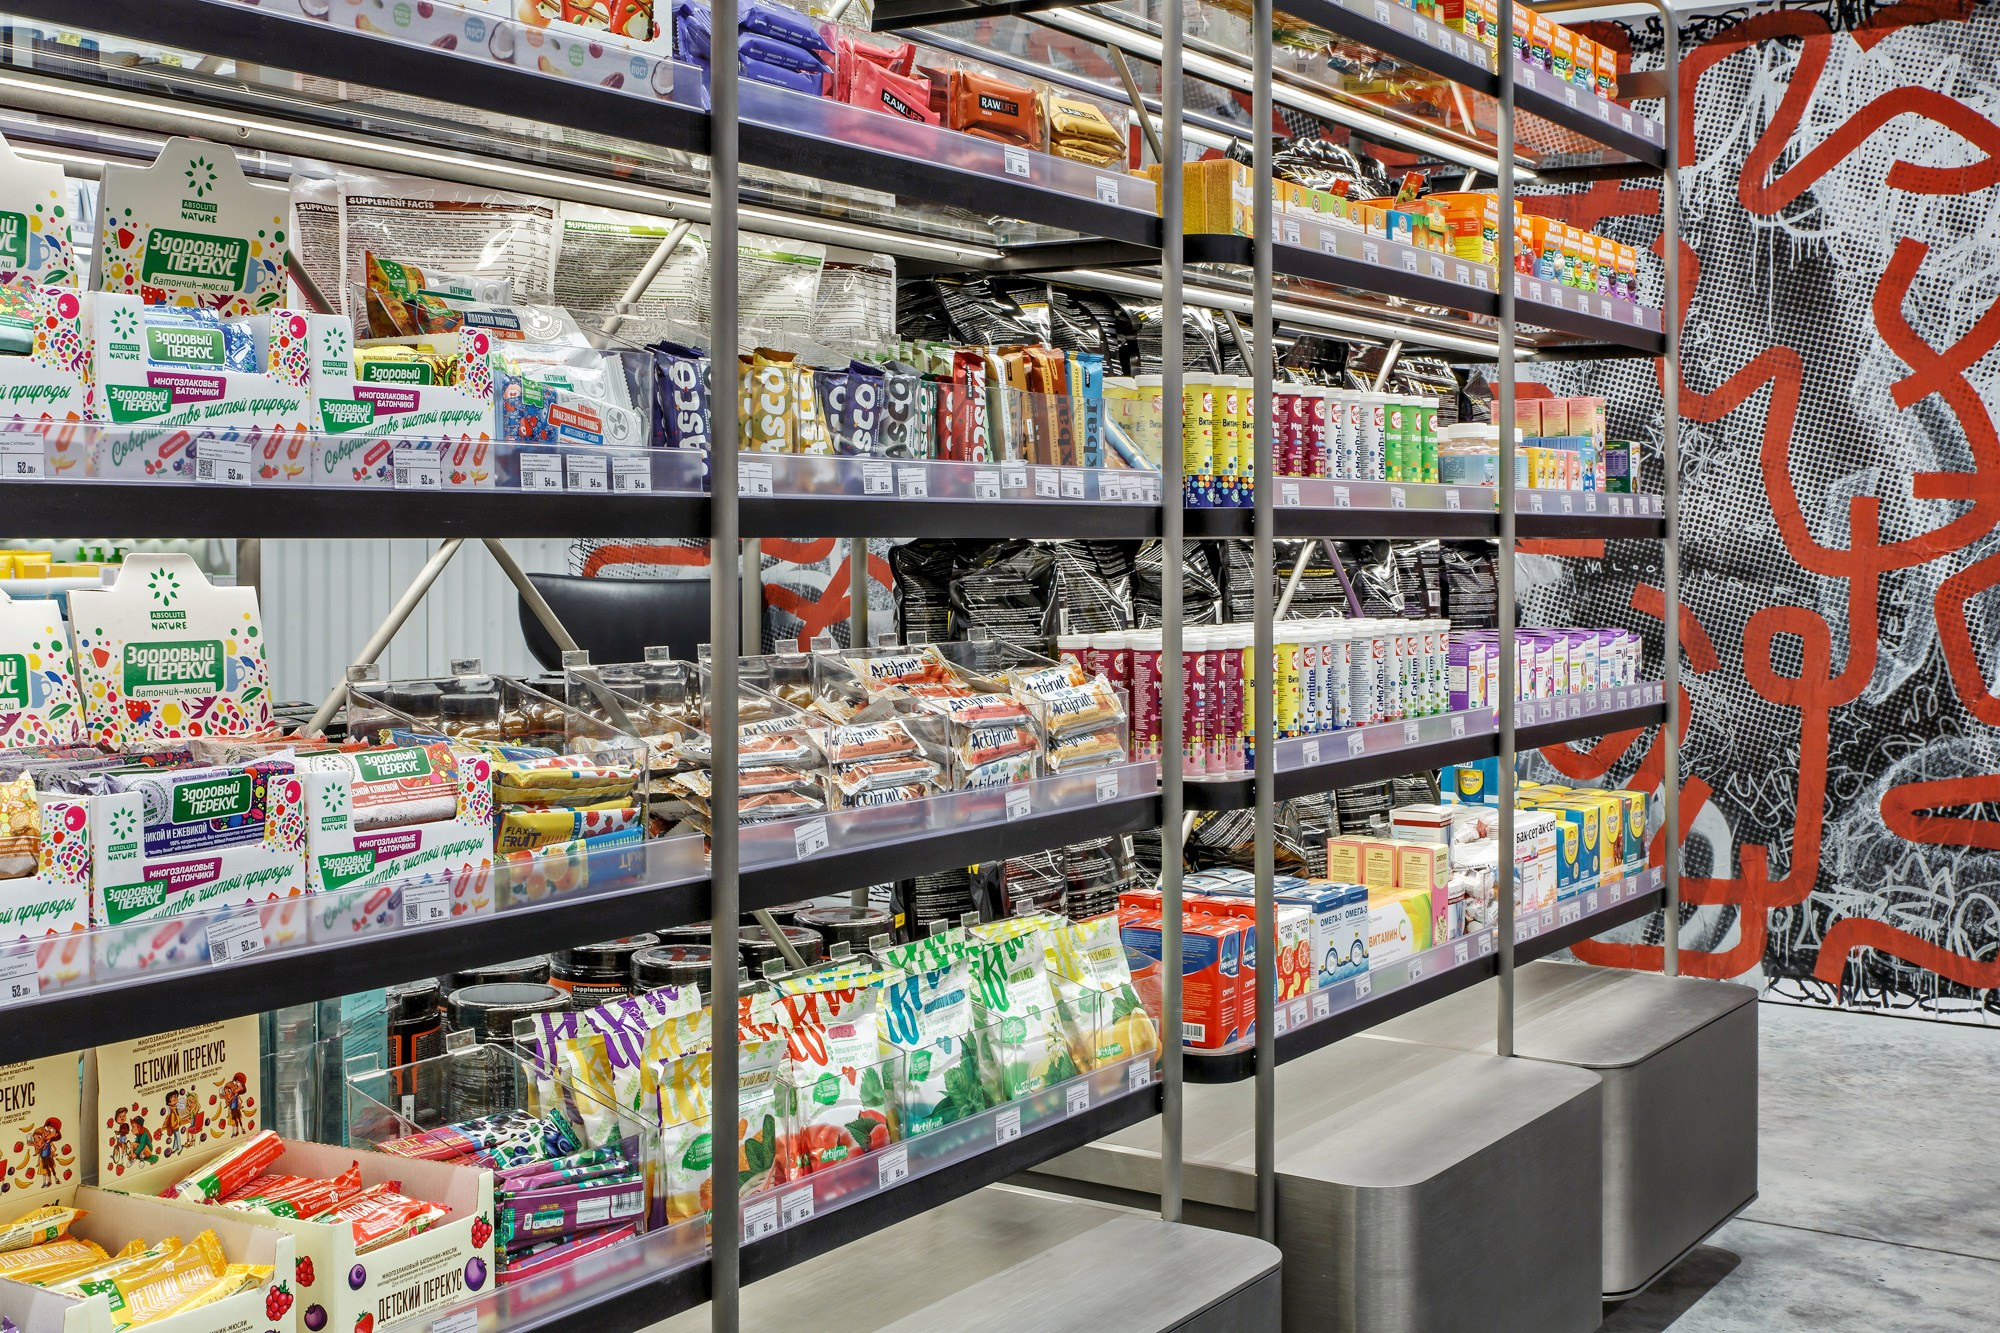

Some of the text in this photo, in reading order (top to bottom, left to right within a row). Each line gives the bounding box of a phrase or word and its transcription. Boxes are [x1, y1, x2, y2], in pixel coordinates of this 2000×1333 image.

[183, 200, 217, 212] ABSOLUTE
[300, 203, 339, 213] SUPPLEME
[349, 196, 435, 210] SUPPLEMENT FACTS
[181, 211, 218, 224] NATURE
[150, 232, 241, 259] Здоровый
[167, 253, 238, 277] ПЕРЕКУС
[155, 330, 213, 348] Здоровый
[110, 343, 140, 351] ABSOLUTE
[167, 345, 214, 360] ПЕРЕКУС
[109, 352, 140, 361] NATURE
[323, 360, 347, 369] ABSOLUTE
[322, 368, 347, 377] NATURE
[369, 365, 420, 381] Здоровый
[153, 377, 220, 389] МНОГОЗЛАКОВЫЕ
[8, 384, 72, 405] природы
[110, 387, 168, 403] Здоровый
[175, 386, 220, 397] БАТОНЧИКИ
[358, 391, 414, 401] МНОГОЗЛАКОВЫЕ
[122, 399, 167, 413] ПЕРЕКУС
[248, 397, 300, 418] природы
[323, 400, 371, 415] Здоровый
[377, 399, 414, 409] БАТОНЧИКИ
[333, 411, 370, 424] ПЕРЕКУС
[438, 408, 484, 427] природы
[151, 611, 186, 619] ABSOLUTE
[151, 621, 188, 631] NATURE
[127, 643, 216, 664] Здоровый
[147, 660, 216, 681] ПЕРЕКУС
[872, 658, 922, 679] Actifruit
[1025, 673, 1069, 694] Actifruit
[1052, 693, 1095, 715] Actifruit
[1307, 669, 1316, 724] L-Carnitine
[971, 727, 1017, 750] Actifruit
[363, 750, 417, 766] Здоровый
[376, 761, 420, 776] ПЕРЕКУС
[182, 781, 241, 803] Здоровый
[351, 782, 400, 797] ЕСНОЙ КЛЮКВОЙ
[191, 795, 239, 815] ПЕРЕКУС
[322, 815, 347, 823] ABSOLUTE
[144, 829, 166, 843] НИКОЙ
[172, 823, 208, 839] ЕЖЕВИКОЙ
[321, 823, 347, 832] NATURE
[108, 843, 137, 852] ABSOLUTE
[359, 834, 416, 848] МНОГОЗЛАКОВЫЕ
[378, 842, 416, 854] БАТОНЧИКИ
[442, 837, 485, 857] природы
[502, 833, 542, 848] FRUIT
[108, 851, 138, 861] NATURE
[322, 852, 372, 870] Здоровый
[149, 861, 215, 878] МНОГОЗЛАКОВЫЕ
[170, 870, 215, 884] БАТОНЧИКИ
[243, 863, 294, 887] природы
[332, 862, 371, 877] ПЕРЕКУС
[108, 882, 164, 901] Здоровый
[8, 897, 77, 922] природы
[118, 894, 161, 911] ПЕРЕКУС
[1320, 913, 1342, 927] ОМЕГА-3
[1344, 906, 1368, 919] ОМЕГА-3
[1368, 929, 1398, 947] ВИТАМИН
[572, 984, 628, 995] Supplement Facts
[133, 1039, 226, 1089] ДЕТСКИЙ ПЕРЕКУС
[821, 1147, 848, 1161] Actifruit
[382, 1260, 420, 1280] МНОГОЗЛАКОВЫЙ
[129, 1274, 179, 1315] ДЕТСКИЙ
[378, 1268, 462, 1324] ДЕТСКИЙ ПЕРЕКУС
